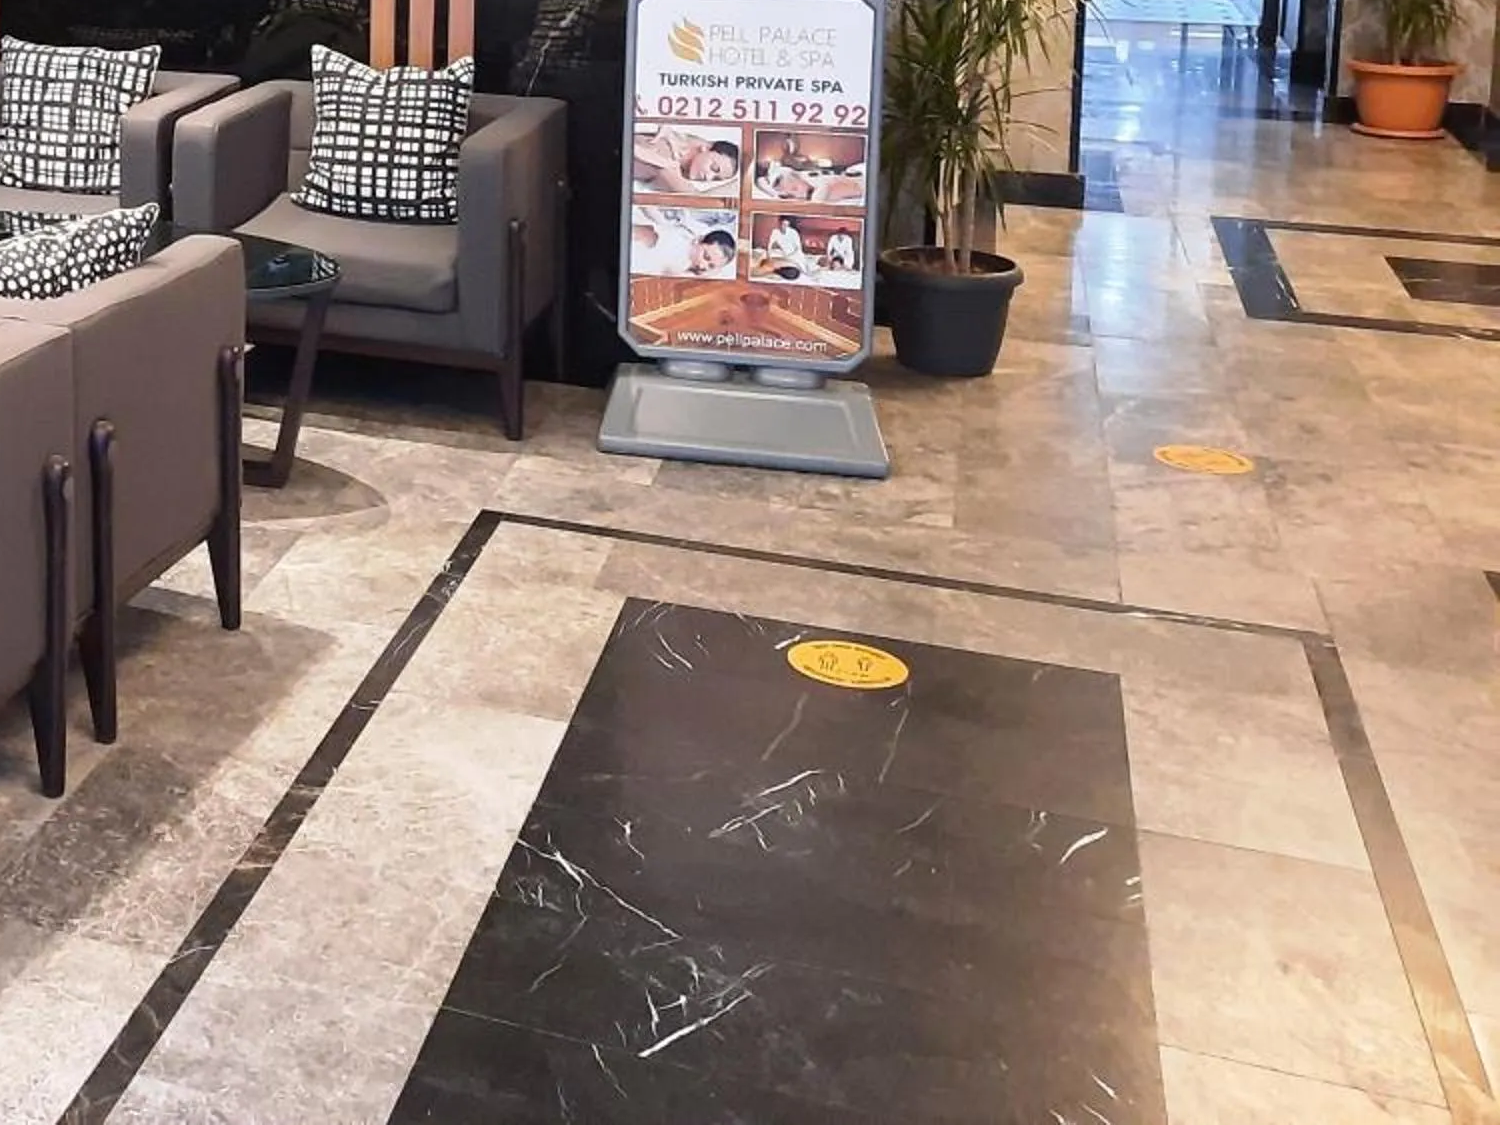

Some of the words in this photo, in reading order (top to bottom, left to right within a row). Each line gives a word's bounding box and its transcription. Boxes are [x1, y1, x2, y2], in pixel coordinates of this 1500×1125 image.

[709, 24, 749, 43] PELL
[759, 26, 837, 47] PALACE
[709, 46, 767, 66] HOTEL
[776, 49, 791, 68] &
[799, 49, 835, 69] SPA
[659, 73, 729, 88] TURKISH
[735, 75, 805, 92] PRIVATE
[810, 80, 844, 93] SPA
[658, 96, 723, 118] 0212
[733, 99, 778, 120] 511
[791, 103, 824, 123] 92
[834, 105, 867, 126] 92
[677, 330, 828, 353] www.pellpalace.com
